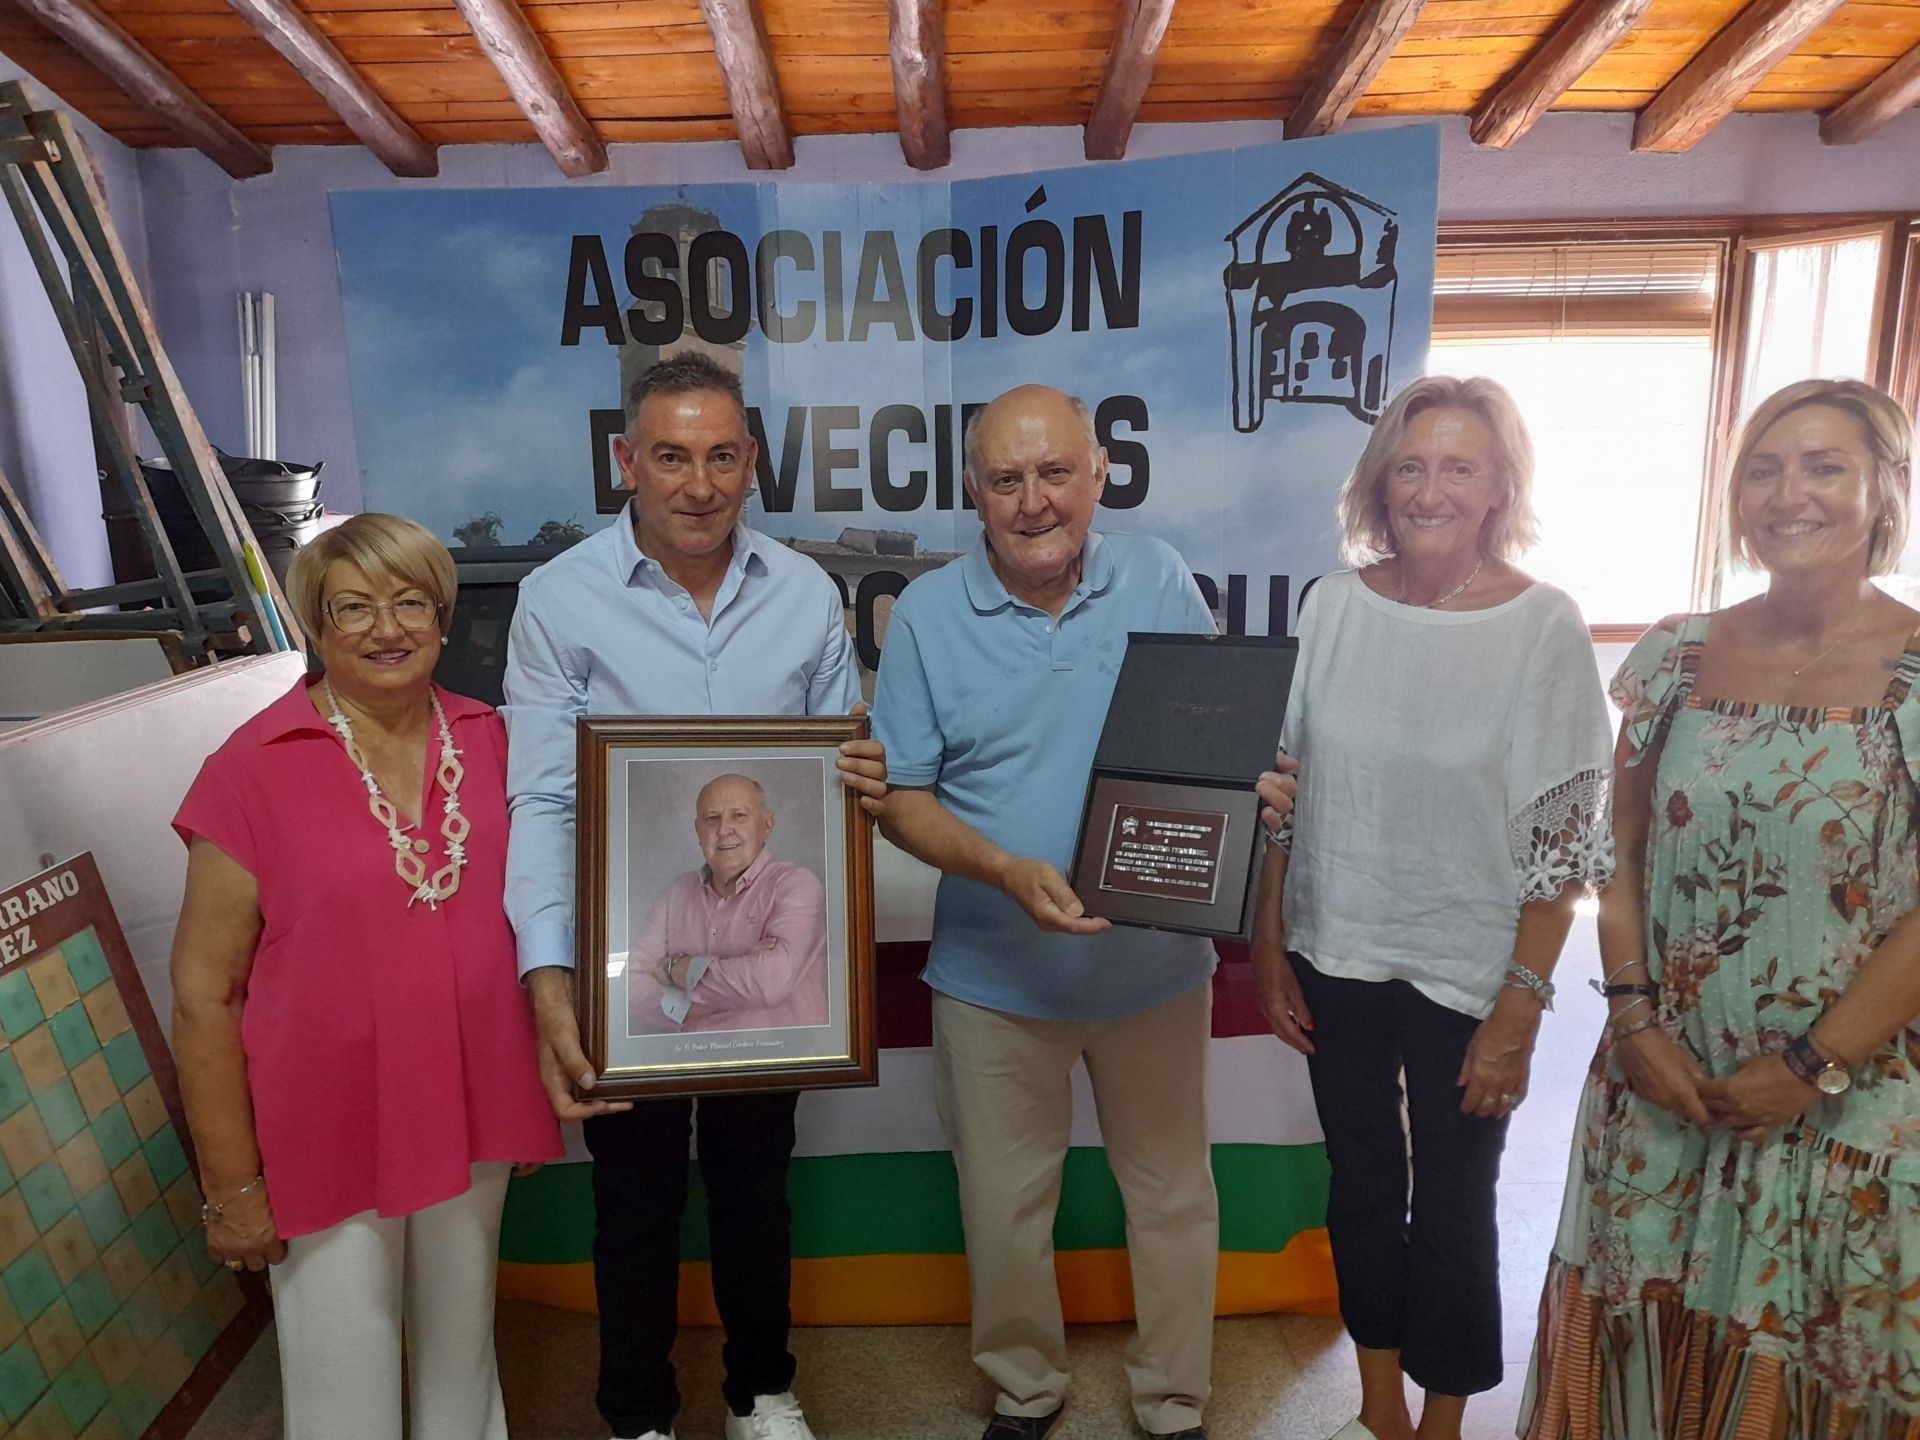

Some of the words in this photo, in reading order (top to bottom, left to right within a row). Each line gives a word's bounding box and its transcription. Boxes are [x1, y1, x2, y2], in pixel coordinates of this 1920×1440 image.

[560, 185, 1142, 346] ASOCIACIÓN
[744, 395, 1150, 513] VECIS
[0, 870, 80, 931] RANO
[0, 924, 38, 969] EZ
